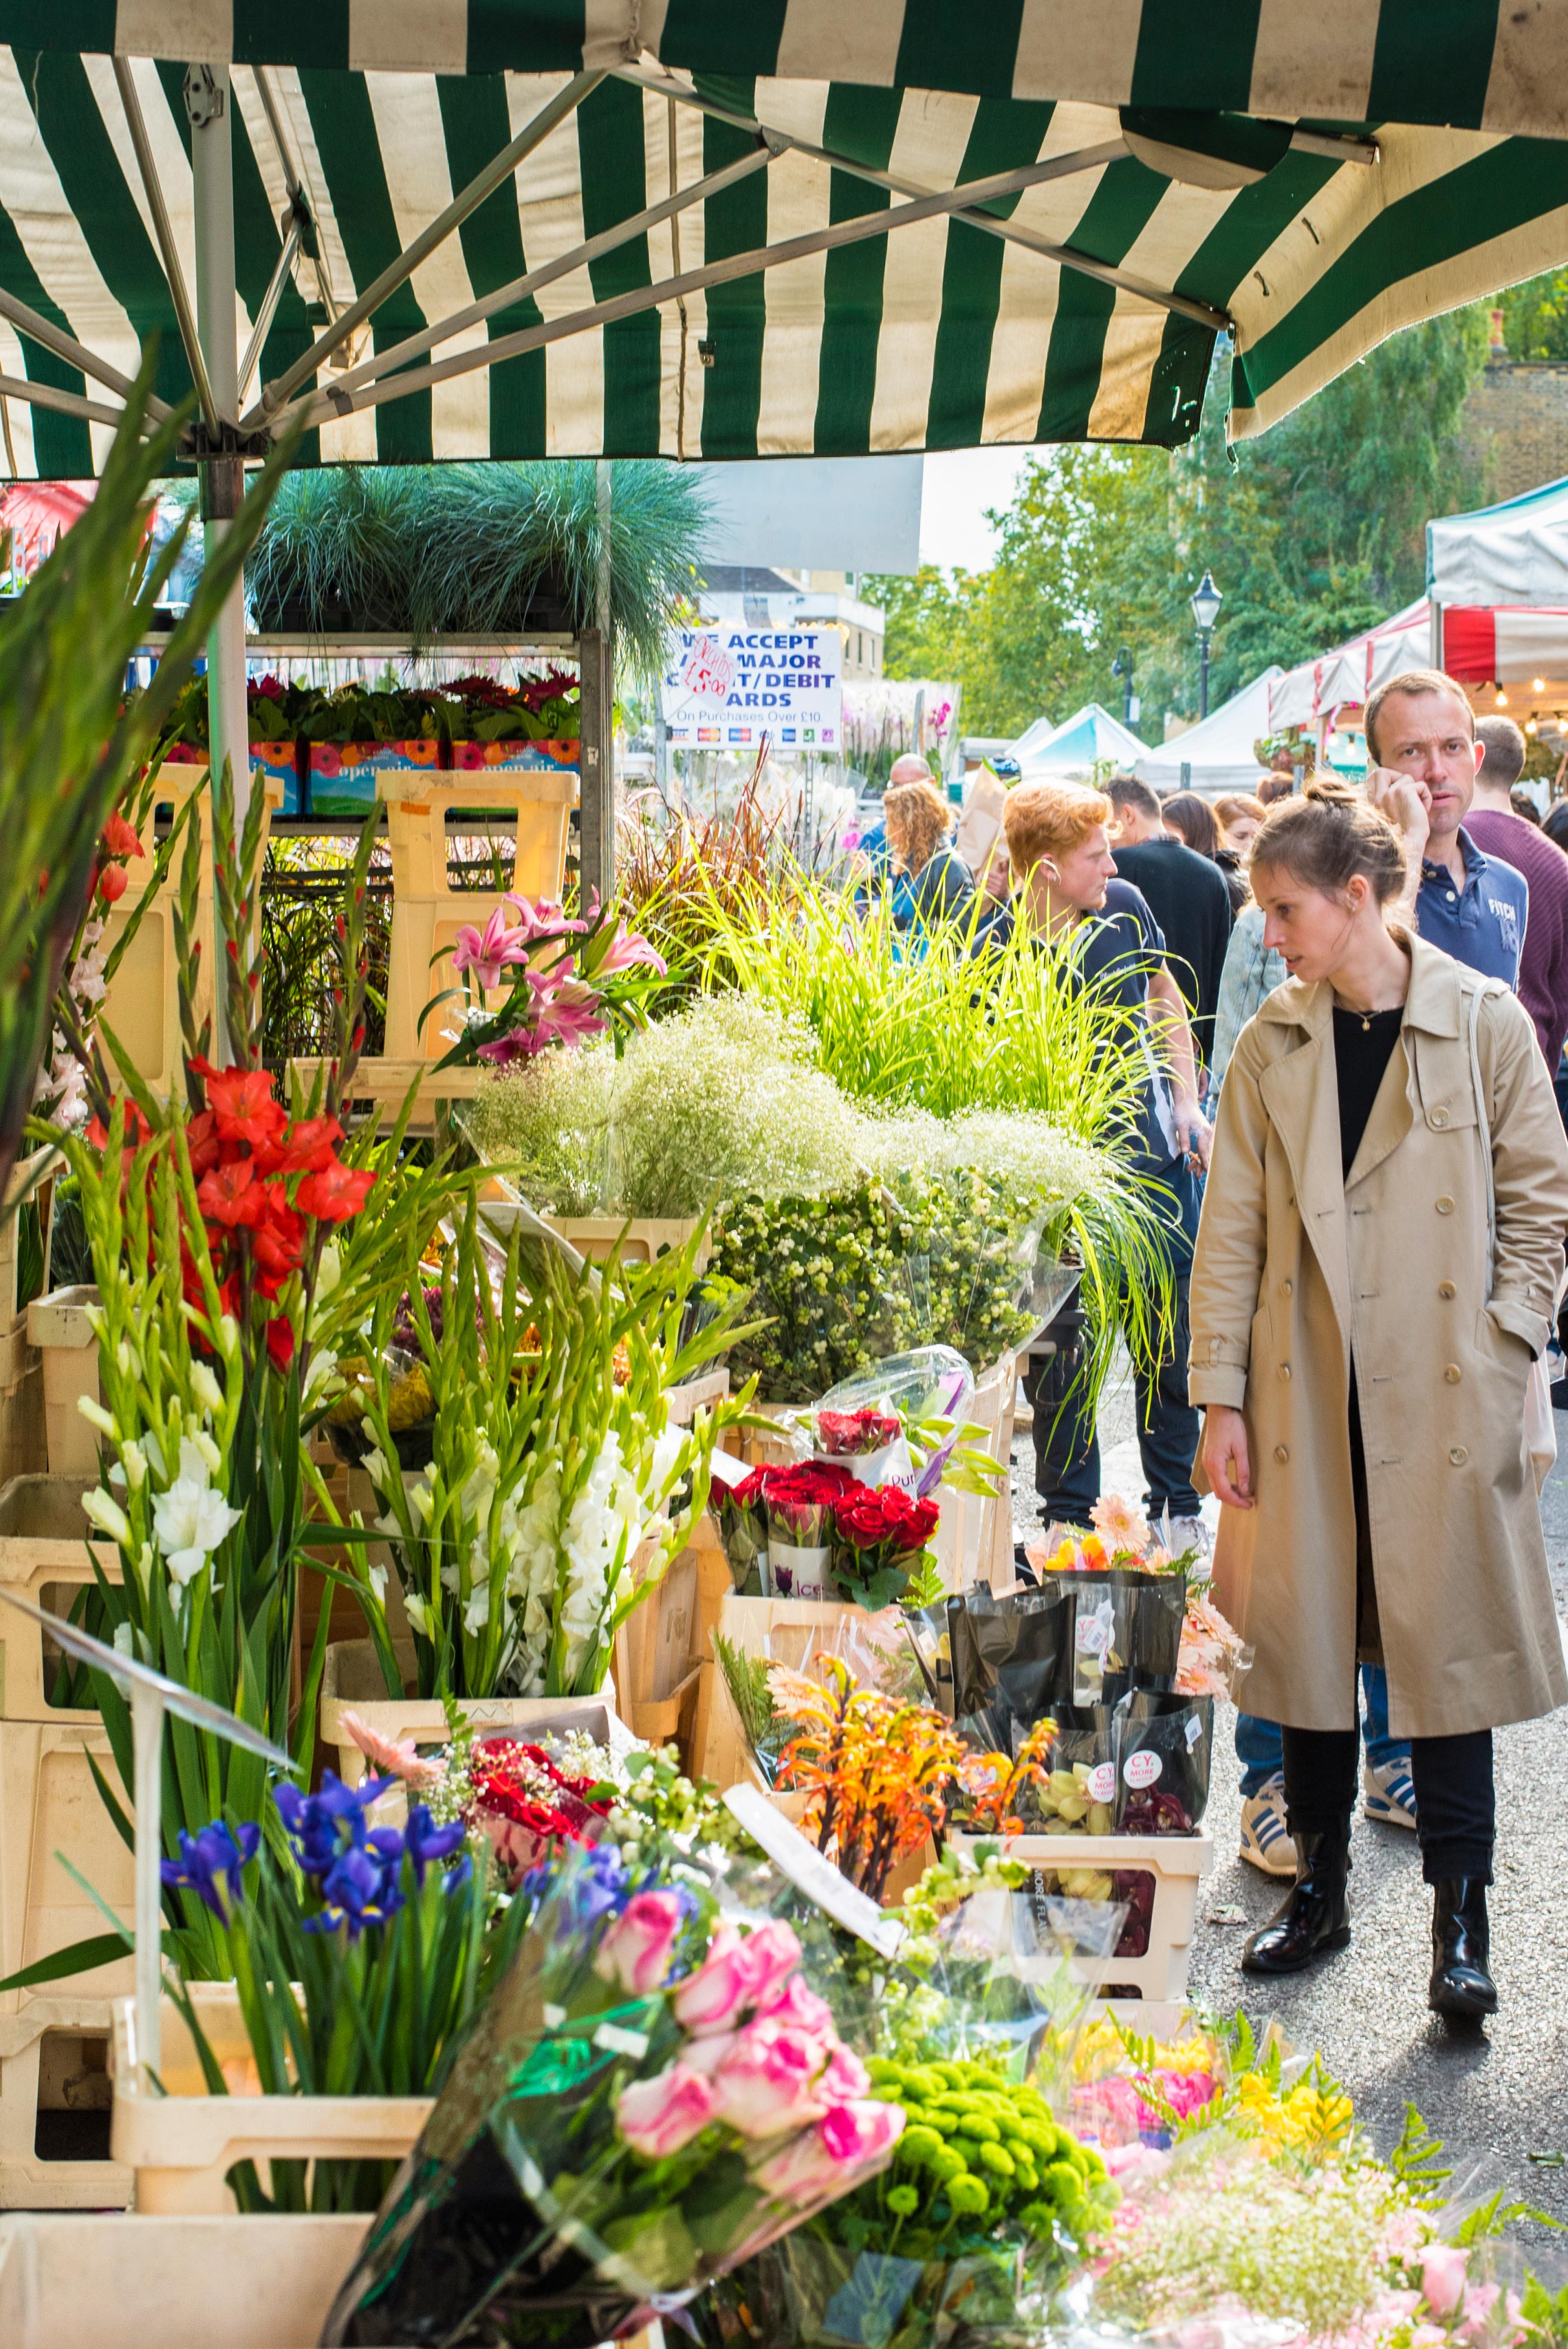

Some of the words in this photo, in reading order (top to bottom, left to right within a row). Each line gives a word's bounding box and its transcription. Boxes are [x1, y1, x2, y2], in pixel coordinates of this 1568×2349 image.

[728, 634, 818, 649] ACCEPT
[737, 654, 821, 669] MAJOR
[726, 693, 792, 707] ARDS
[677, 711, 695, 722] On
[699, 711, 763, 722] Purchases
[767, 711, 796, 722] Over
[1488, 898, 1516, 922] FITCH
[1130, 1768, 1154, 1777] MORE
[1095, 1781, 1114, 1789] MOR
